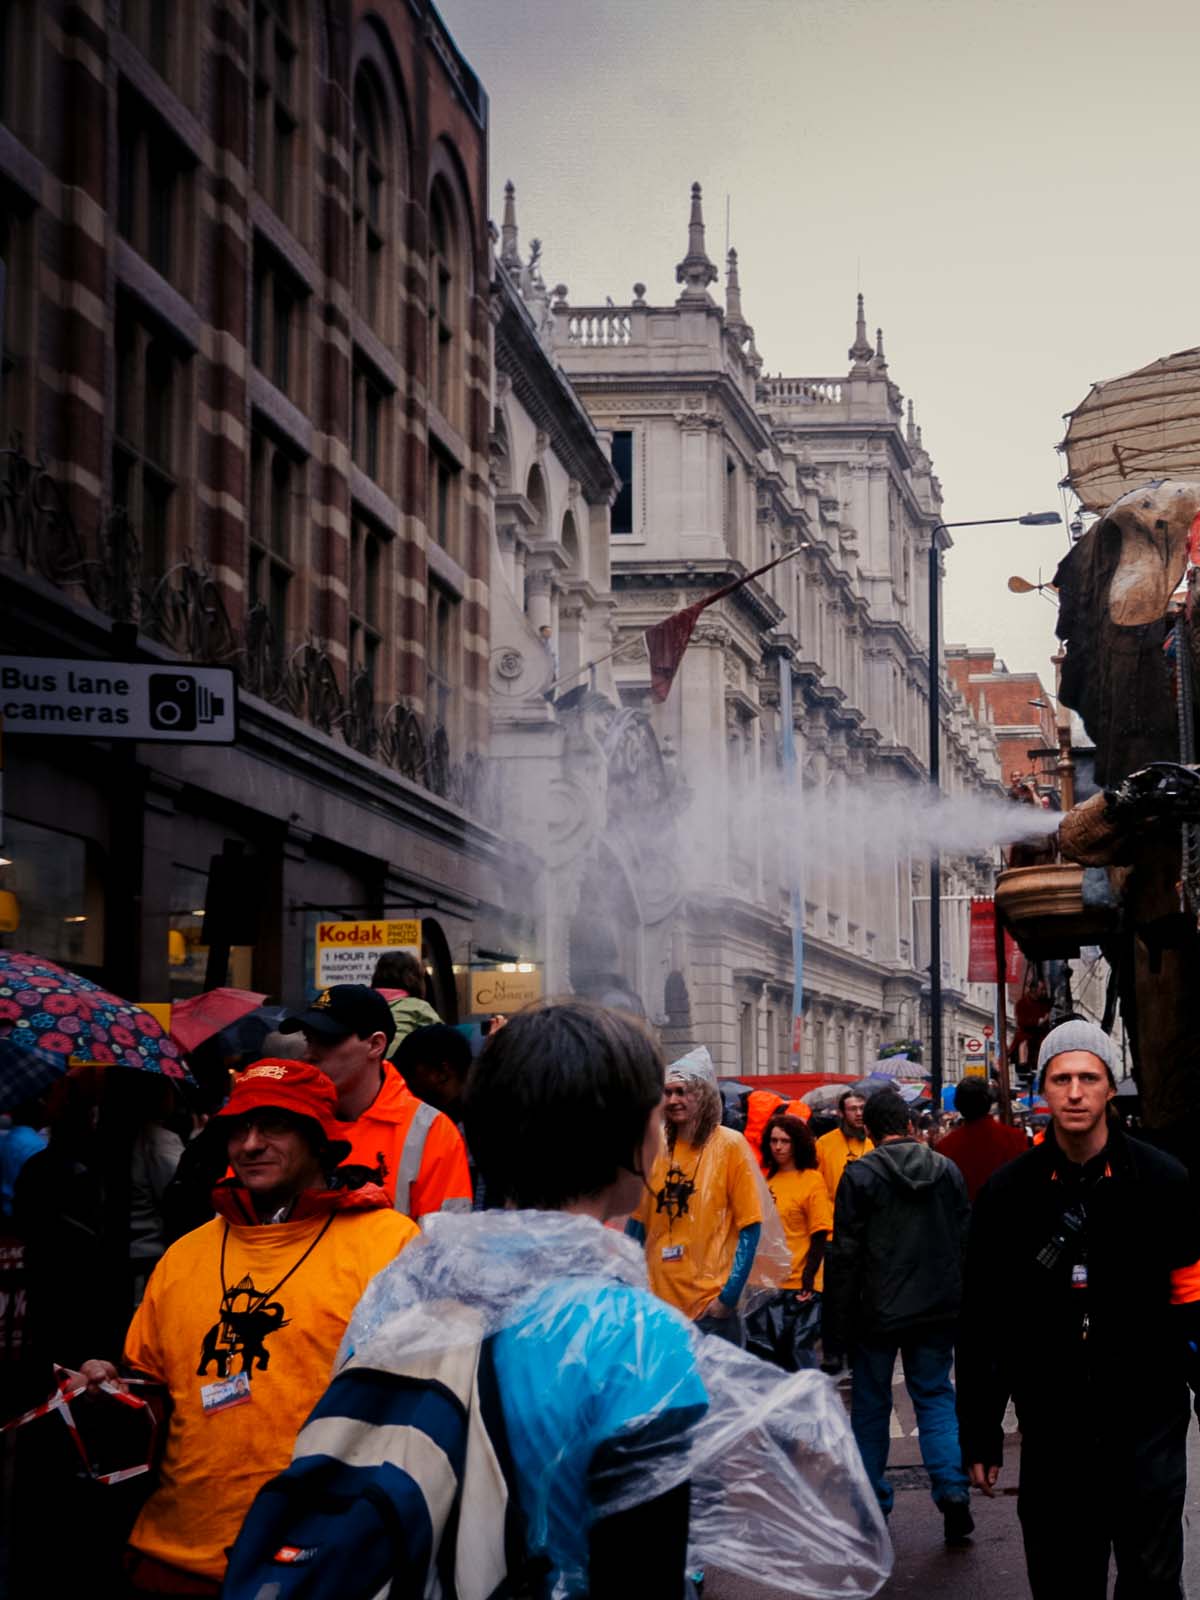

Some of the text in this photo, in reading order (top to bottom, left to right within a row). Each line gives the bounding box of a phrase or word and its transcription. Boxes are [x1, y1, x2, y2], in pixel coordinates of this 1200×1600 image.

[1, 667, 129, 695] Bus lane
[3, 702, 129, 724] cameras
[320, 925, 382, 942] Kodak
[334, 952, 365, 961] HOUR
